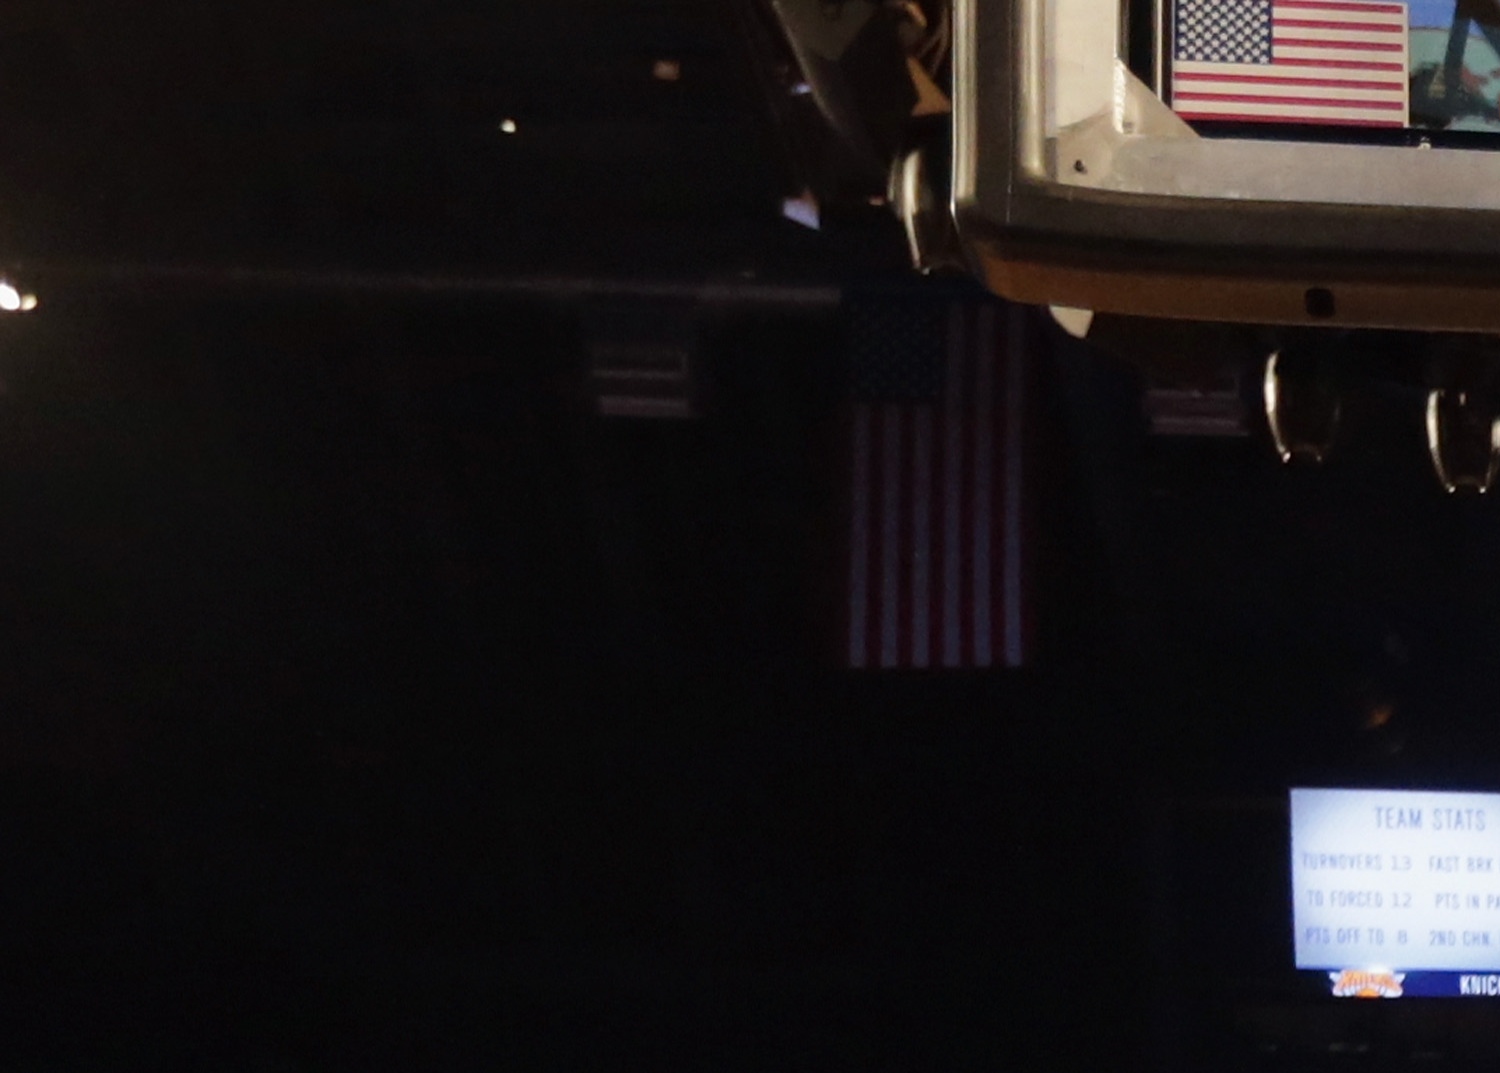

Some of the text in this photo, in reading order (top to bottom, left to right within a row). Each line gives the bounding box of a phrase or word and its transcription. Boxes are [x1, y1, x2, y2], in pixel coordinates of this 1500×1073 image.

[1374, 806, 1486, 831] TEAM STATS
[1302, 853, 1413, 872] TURNOVERS 13
[1428, 855, 1459, 873] FAST
[1467, 856, 1493, 873] BRK
[1307, 889, 1324, 907] TO
[1330, 890, 1383, 908] FORCED
[1435, 893, 1460, 910] PTS
[1466, 894, 1480, 910] IN
[1305, 927, 1330, 945] PTS
[1337, 927, 1361, 945] OFF
[1429, 929, 1456, 946] 2ND
